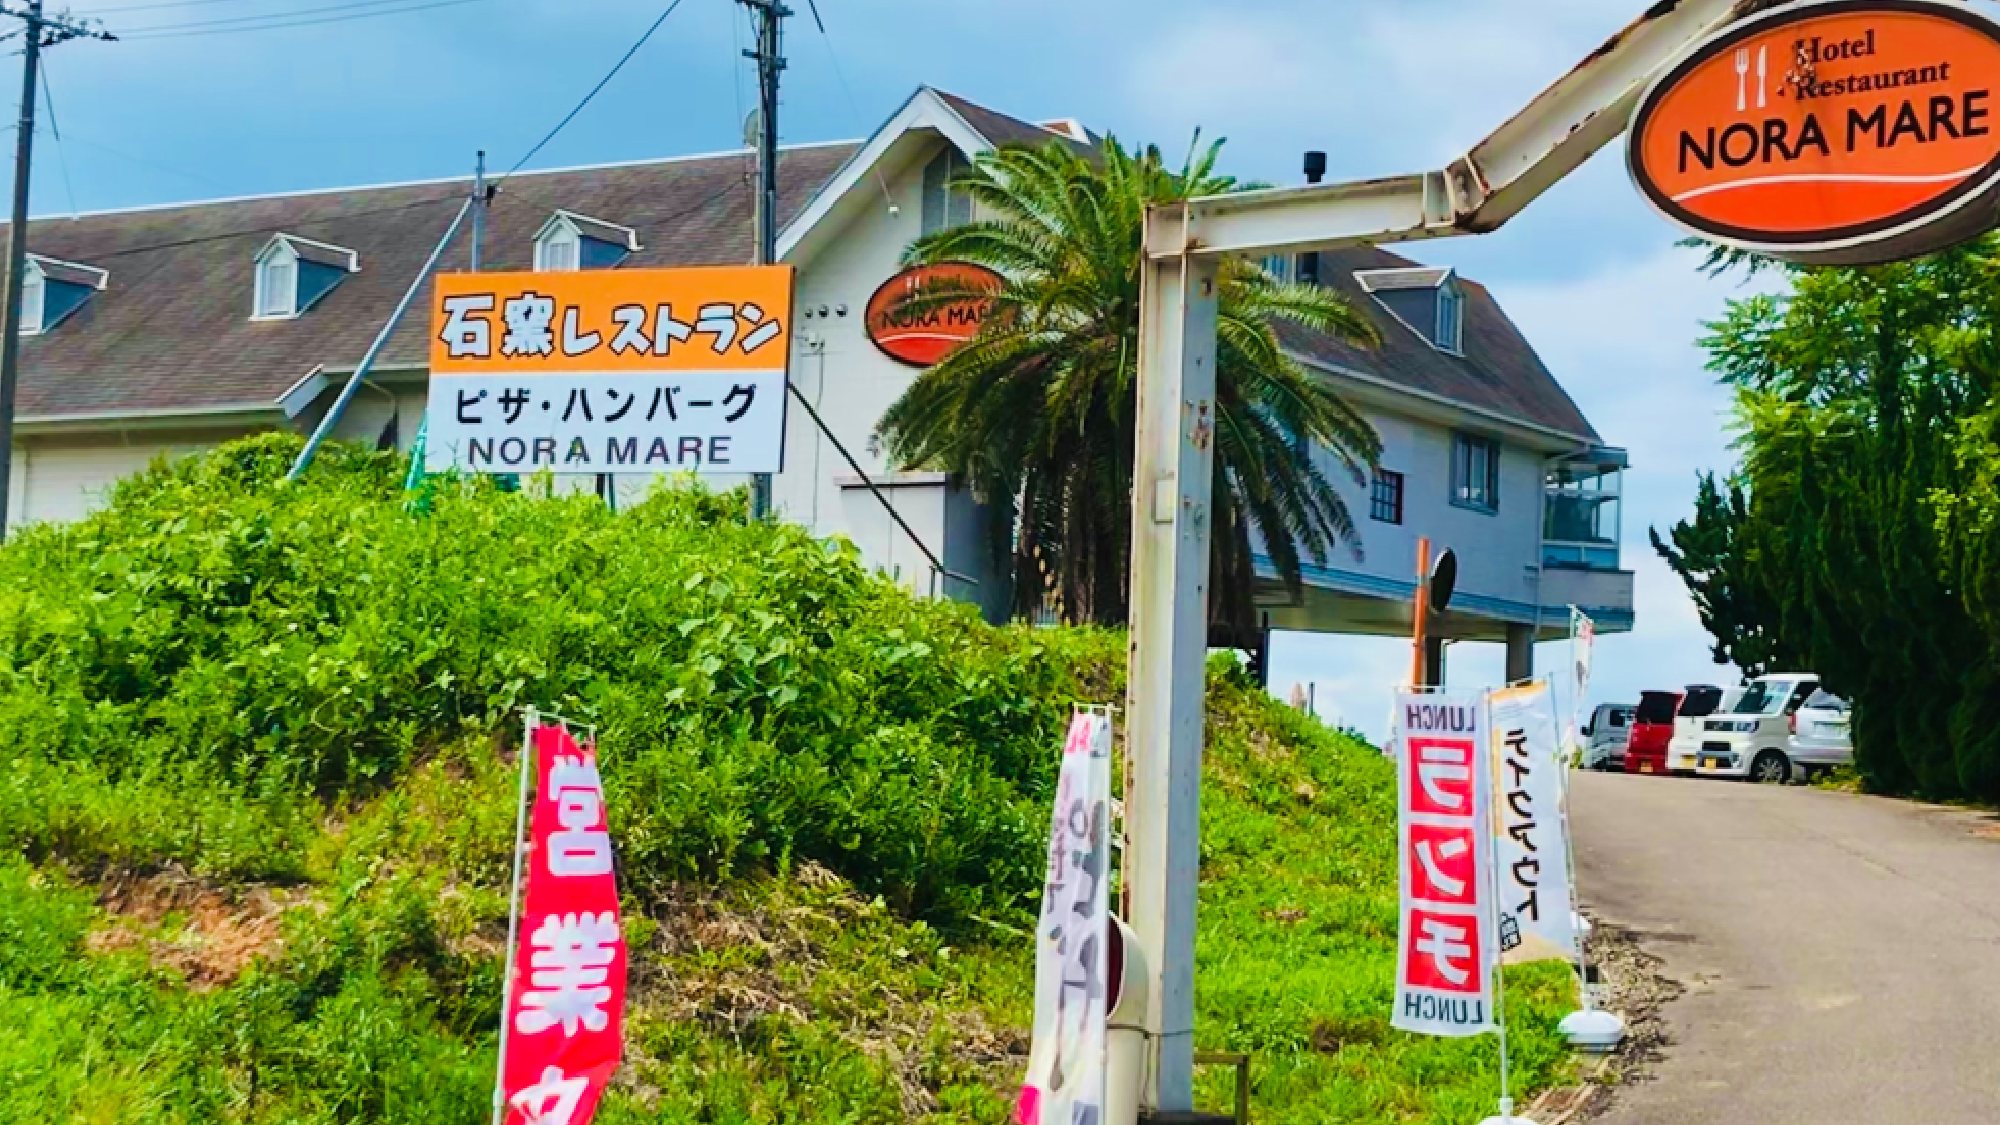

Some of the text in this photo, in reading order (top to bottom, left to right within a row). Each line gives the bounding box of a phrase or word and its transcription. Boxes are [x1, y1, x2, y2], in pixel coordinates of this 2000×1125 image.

[1794, 29, 1876, 63] Hotel
[1796, 62, 1951, 101] Restaurant
[1678, 89, 1990, 173] NORA MARE
[439, 291, 782, 360] 石窯レストラン
[456, 383, 757, 425] ピザ・ハンバーグ
[468, 436, 732, 465] NORA MARE
